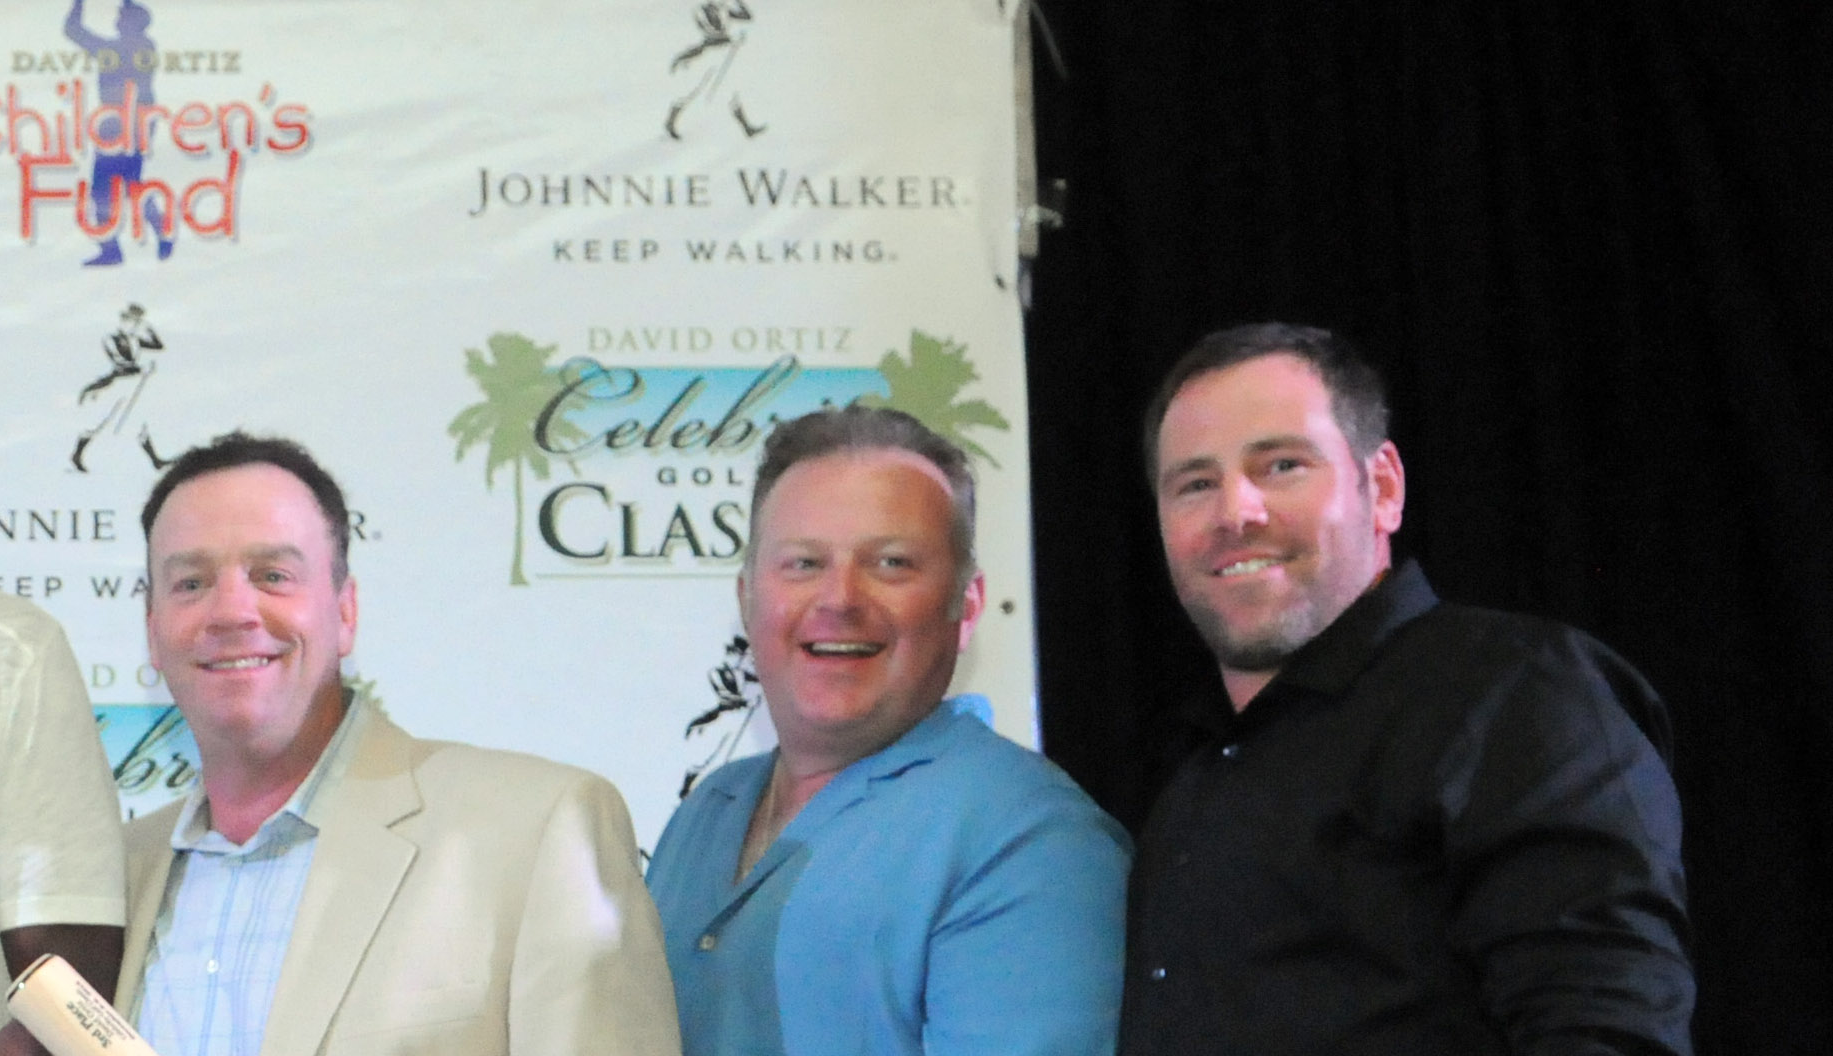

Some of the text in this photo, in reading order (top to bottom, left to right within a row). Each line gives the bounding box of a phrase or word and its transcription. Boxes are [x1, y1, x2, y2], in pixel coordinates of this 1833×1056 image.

[11, 51, 242, 74] DAVID ORTIZ
[19, 150, 239, 240] Fund
[469, 168, 711, 217] JOHNNIE
[553, 239, 660, 262] KEEP
[587, 326, 855, 352] DAVID ORTIZ
[533, 355, 861, 457] Celeb
[656, 467, 744, 486] GOL
[538, 482, 747, 562] CLAS
